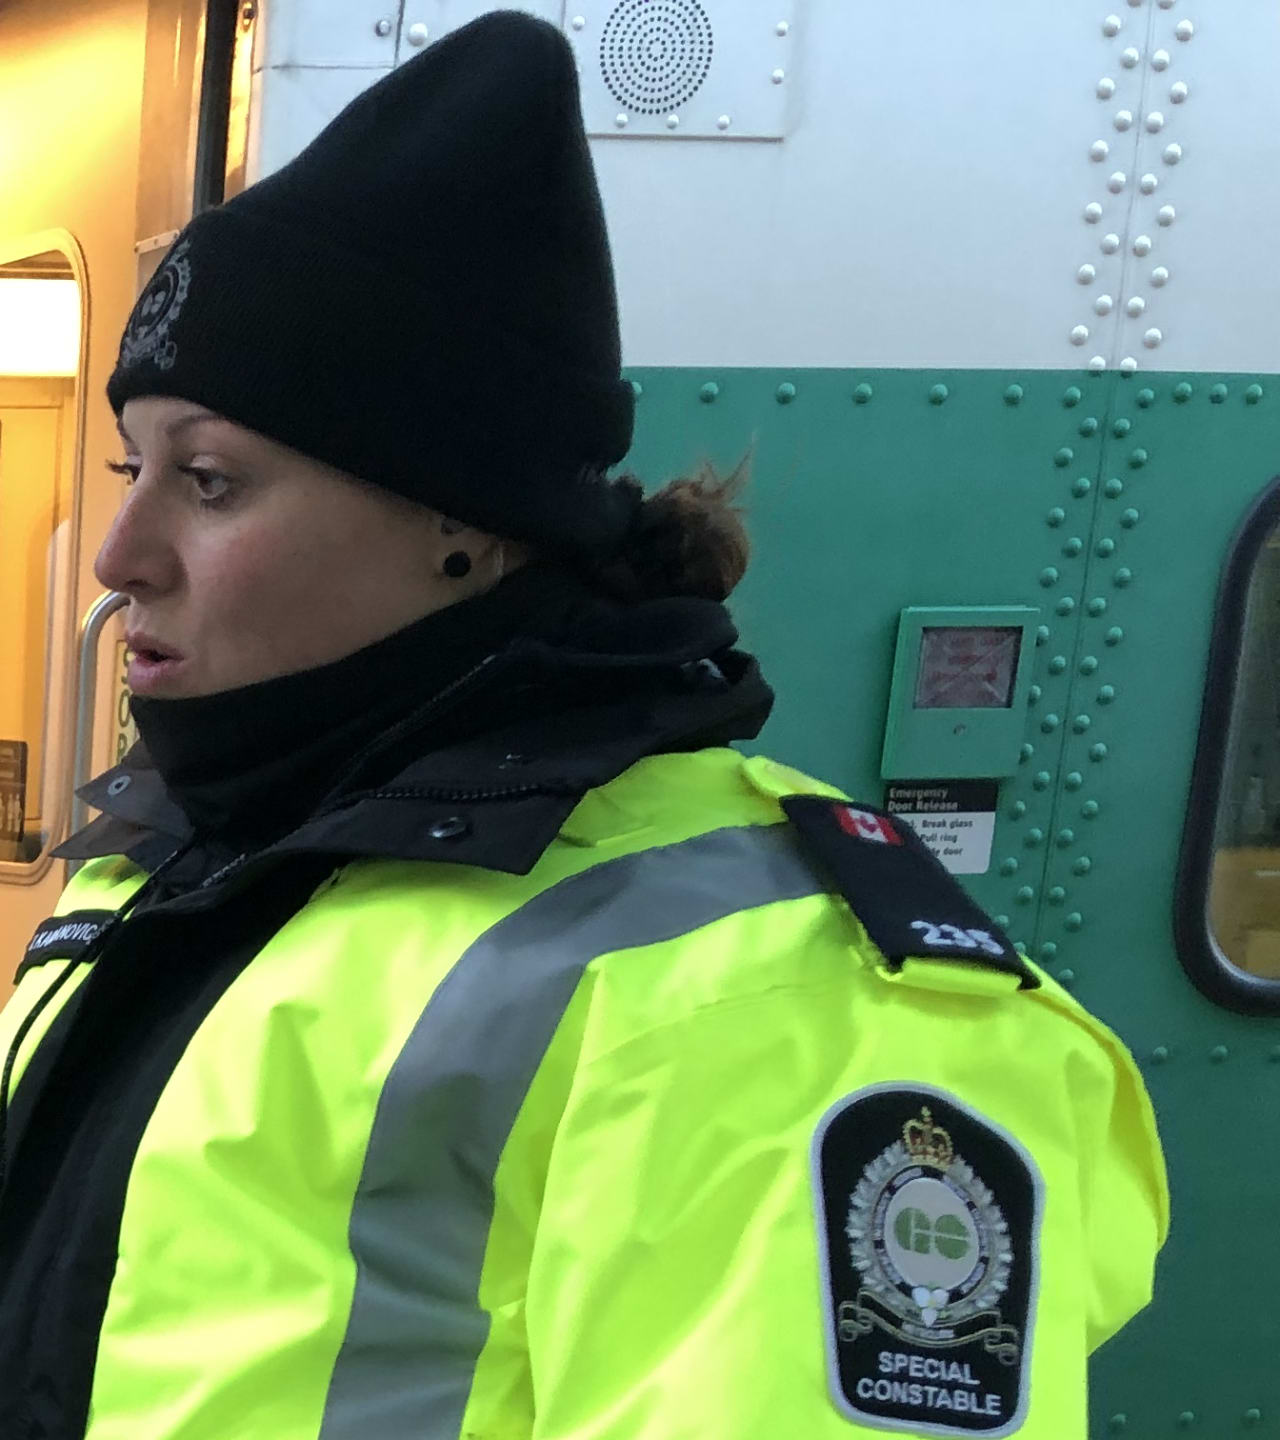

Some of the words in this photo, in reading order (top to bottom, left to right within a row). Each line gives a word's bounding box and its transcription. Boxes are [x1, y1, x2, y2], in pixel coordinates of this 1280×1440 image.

[889, 787, 948, 799] Emergency
[888, 801, 913, 812] Door
[916, 801, 958, 811] Release
[922, 819, 946, 828] Break
[949, 819, 974, 829] glass
[940, 833, 958, 843] ring
[943, 847, 963, 855] door
[878, 1351, 981, 1386] SPECIAL
[856, 1377, 1002, 1417] CONSTABLE
